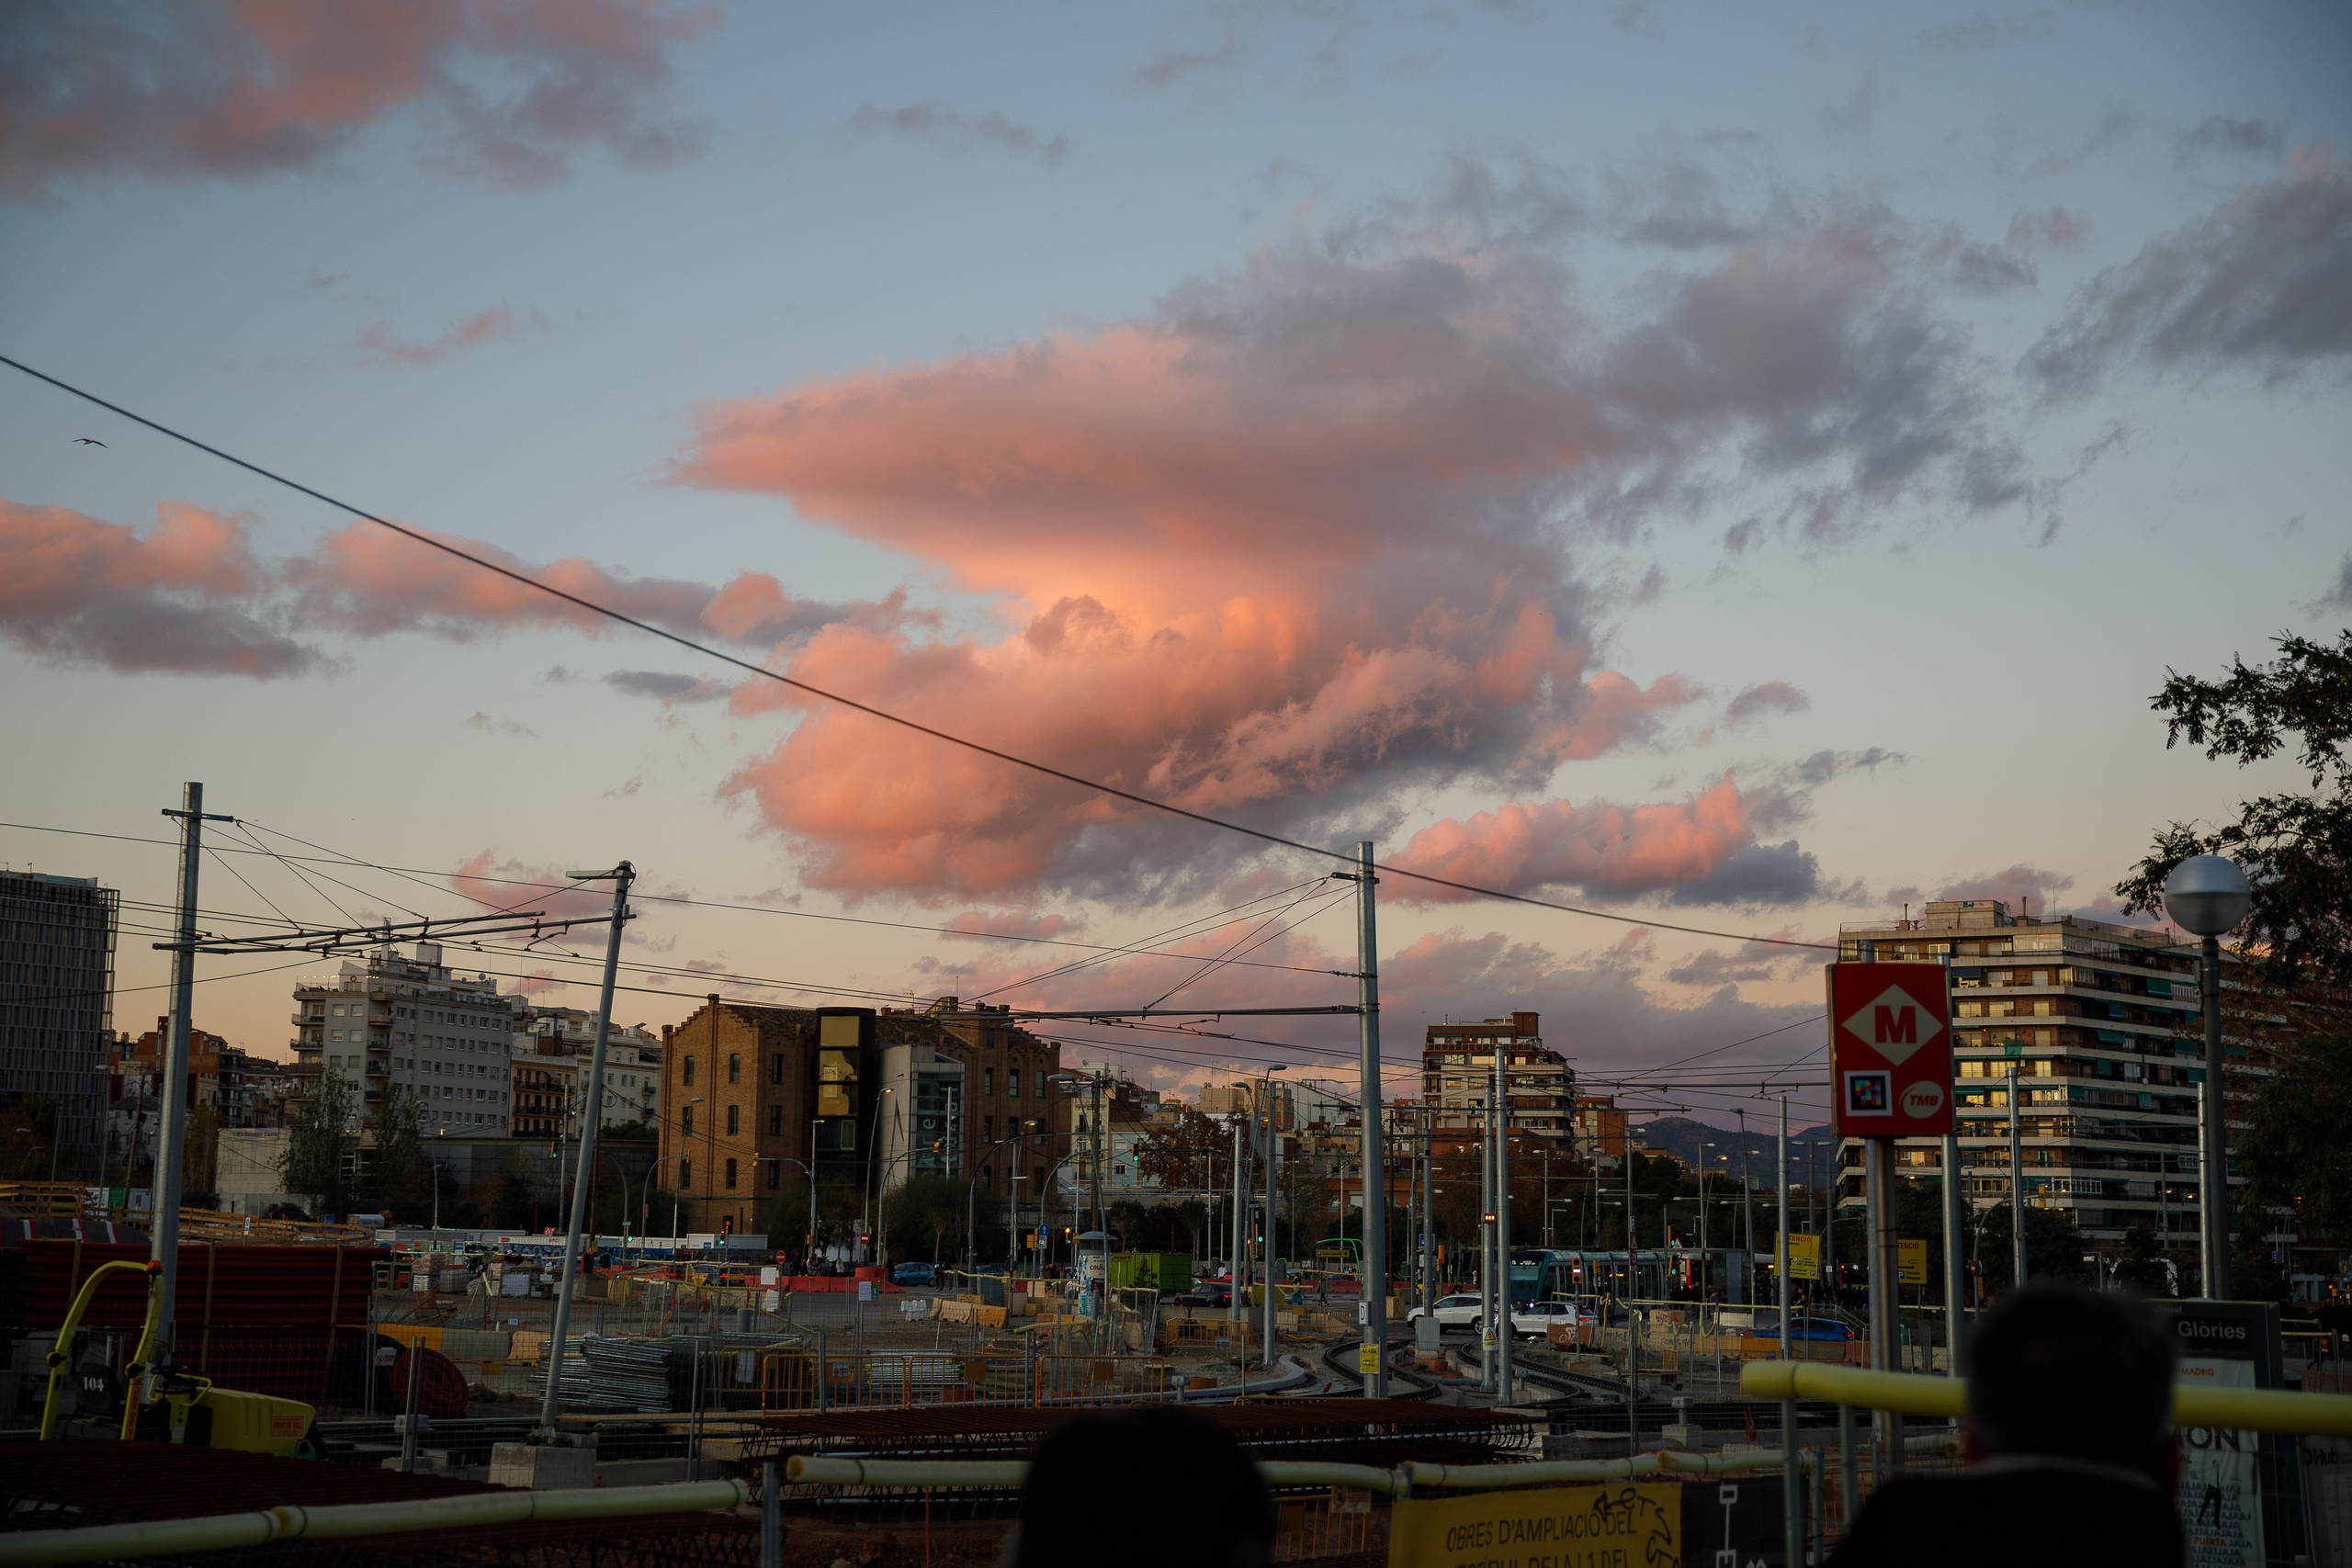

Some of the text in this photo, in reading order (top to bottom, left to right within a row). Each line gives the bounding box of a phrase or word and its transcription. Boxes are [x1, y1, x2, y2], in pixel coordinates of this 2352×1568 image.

[1874, 1005, 1917, 1043] M
[1909, 1094, 1939, 1107] TMB
[1361, 1305, 1365, 1320] D
[2177, 1320, 2246, 1340] Glòries
[2181, 1368, 2215, 1376] MADRID
[83, 1376, 105, 1393] 104
[1446, 1521, 1494, 1552] OBRES
[1605, 1510, 1637, 1536] DEL
[2193, 1537, 2253, 1549] PUERTA JAJA
